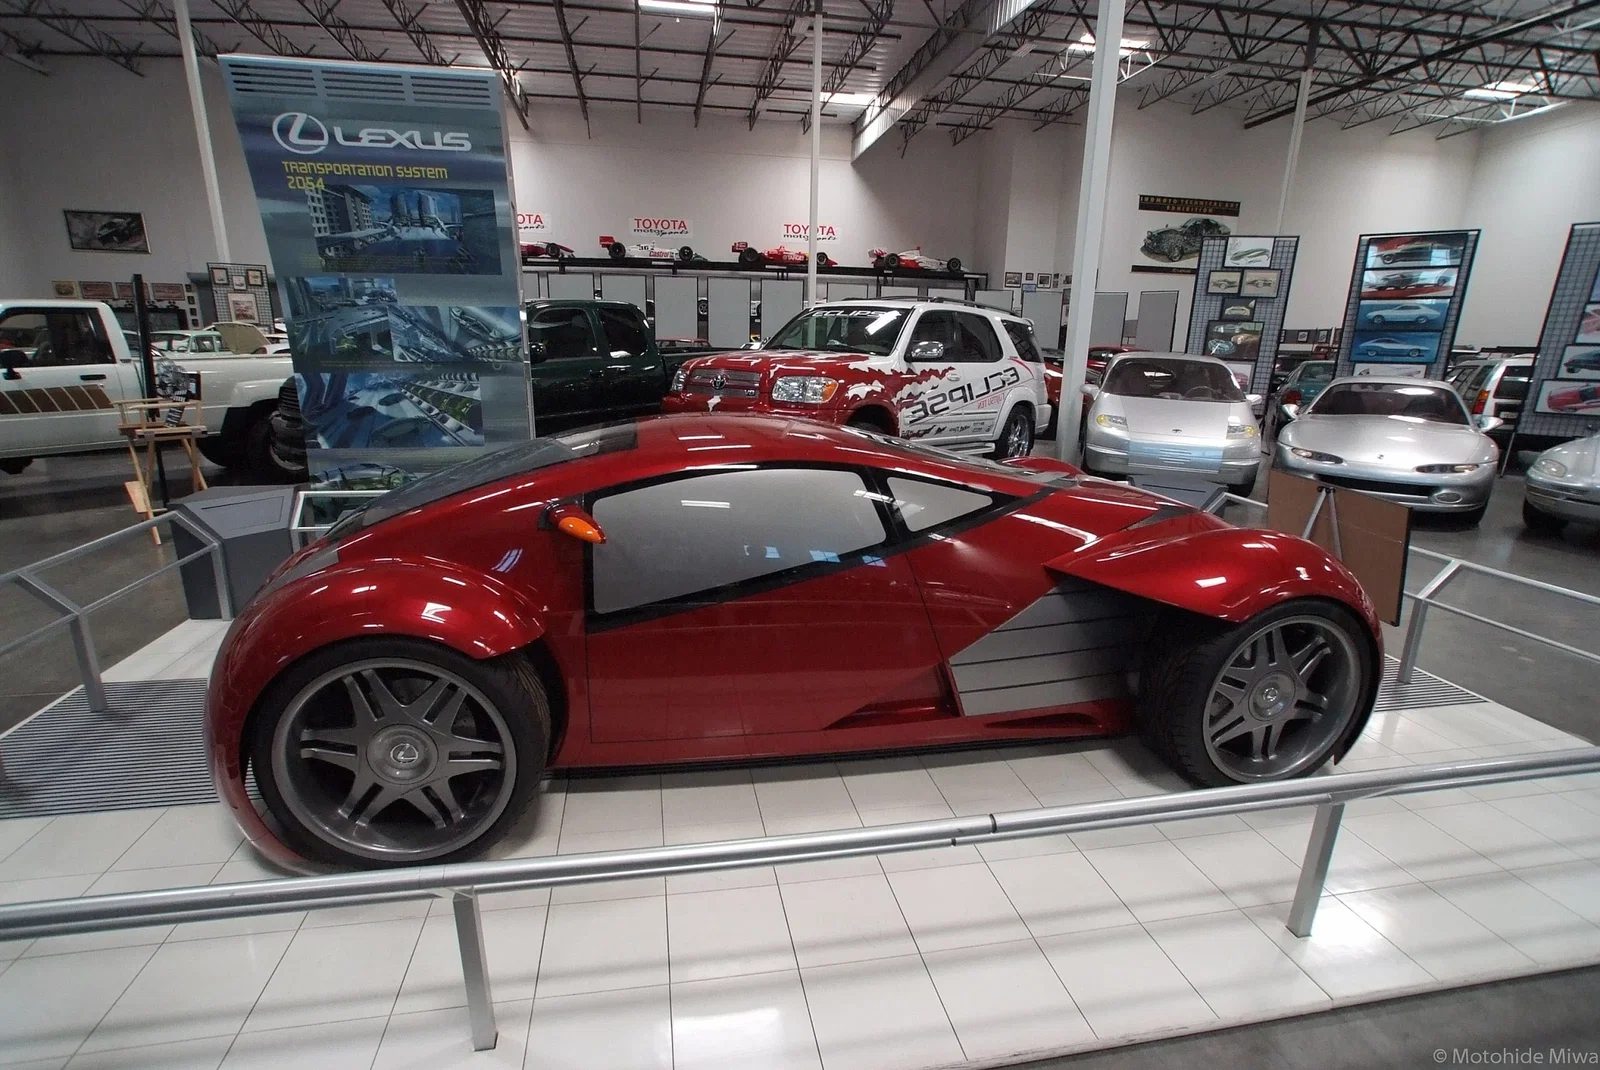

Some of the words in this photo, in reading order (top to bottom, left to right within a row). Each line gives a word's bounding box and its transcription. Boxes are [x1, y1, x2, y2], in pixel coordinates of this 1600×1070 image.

[333, 126, 472, 151] LEXUS
[287, 176, 325, 190] 2054
[517, 214, 543, 225] OTA
[634, 218, 687, 230] TOYOTA
[783, 224, 836, 236] TOYTA
[649, 250, 670, 258] Castrol
[811, 310, 902, 318] ECLIPS
